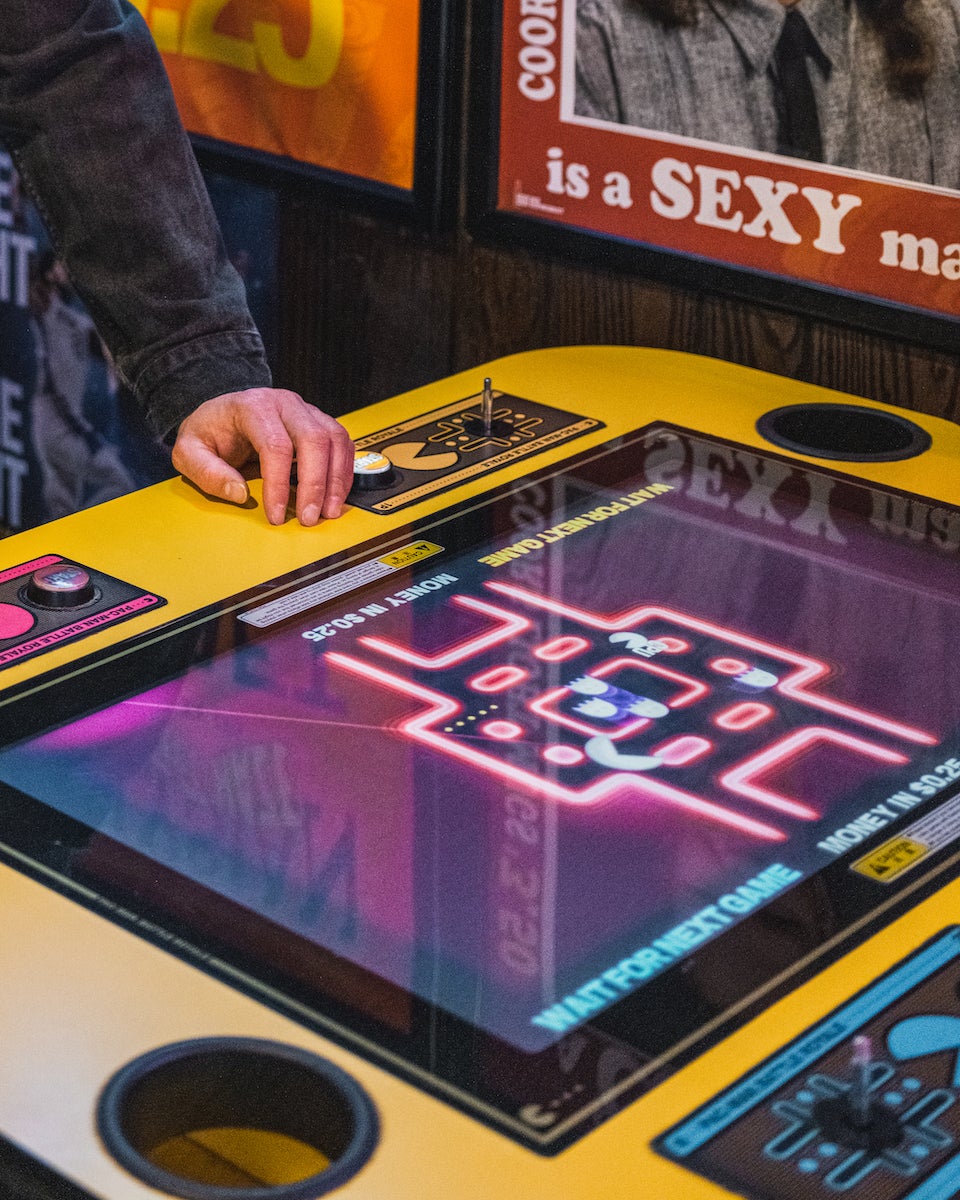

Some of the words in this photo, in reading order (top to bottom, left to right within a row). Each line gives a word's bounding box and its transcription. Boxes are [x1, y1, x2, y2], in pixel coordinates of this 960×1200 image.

[546, 147, 589, 199] is
[602, 172, 633, 209] a
[650, 157, 861, 254] SEXY
[625, 483, 675, 506] WAIT
[584, 498, 631, 522] FOR
[537, 516, 595, 543] NEXT
[477, 538, 544, 568] GAME
[384, 573, 459, 607] MONEY
[85, 605, 134, 627] PAC-MAN
[358, 603, 389, 617] IN
[43, 625, 84, 644] BATTLE
[302, 613, 366, 642] $0.25
[817, 804, 899, 854] MONEY
[887, 791, 921, 809] IN
[909, 758, 960, 795] $0.25
[531, 978, 618, 1032] WAIT
[601, 946, 673, 991] FOR
[653, 904, 732, 956] NEXT
[718, 863, 803, 914] GAME
